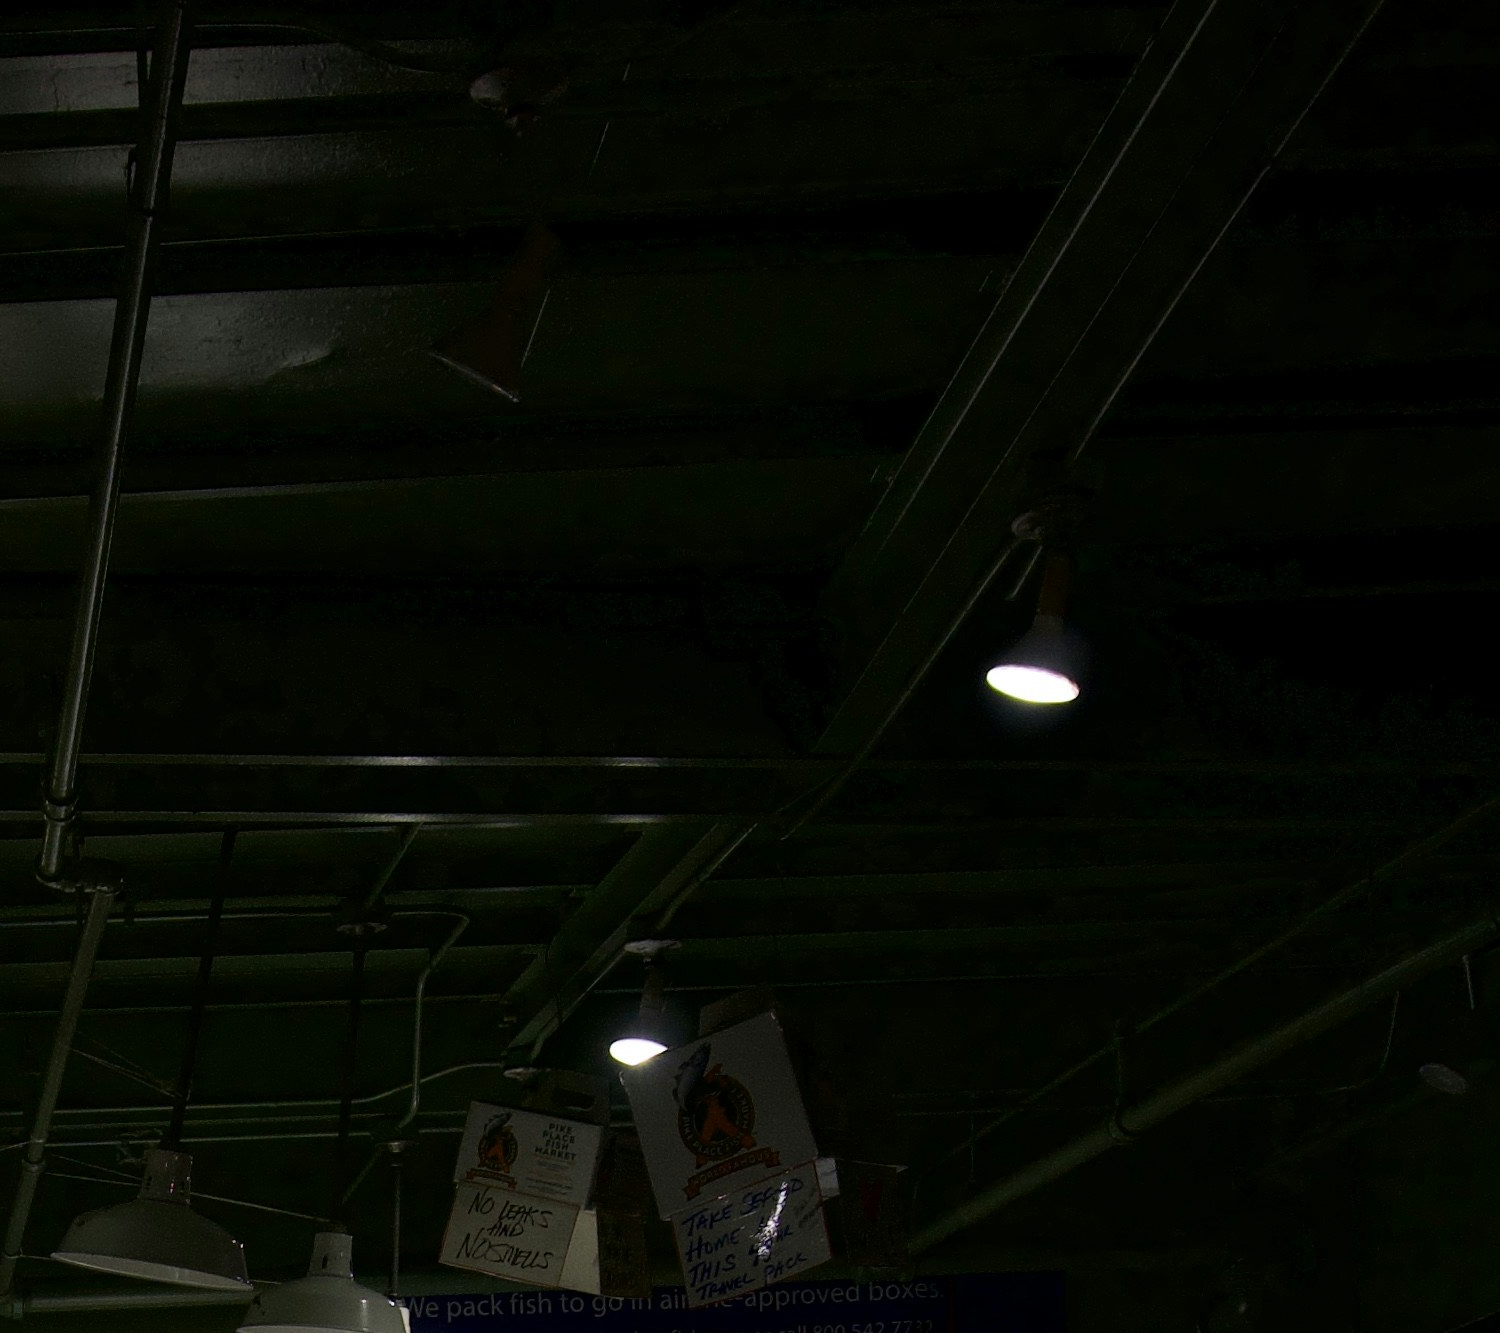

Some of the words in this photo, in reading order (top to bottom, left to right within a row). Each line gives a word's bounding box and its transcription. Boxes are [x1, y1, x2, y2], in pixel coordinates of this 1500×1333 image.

[542, 1130, 576, 1144] PLACE
[545, 1139, 569, 1151] FISH
[549, 1123, 572, 1135] PIKE
[535, 1146, 577, 1161] MARKET
[468, 1187, 495, 1215] NO
[499, 1200, 553, 1229] LEAKS
[682, 1204, 733, 1236] TAKE
[487, 1221, 524, 1238] AND
[685, 1228, 740, 1262] HOME
[689, 1253, 736, 1287] THIS
[696, 1273, 755, 1301] TRAVEL
[765, 1252, 807, 1278] PACK
[405, 1299, 439, 1318] We
[446, 1295, 503, 1322] pack
[510, 1292, 553, 1315] fish
[560, 1294, 585, 1314] to
[591, 1295, 623, 1320] go
[869, 1279, 945, 1301] boxes.
